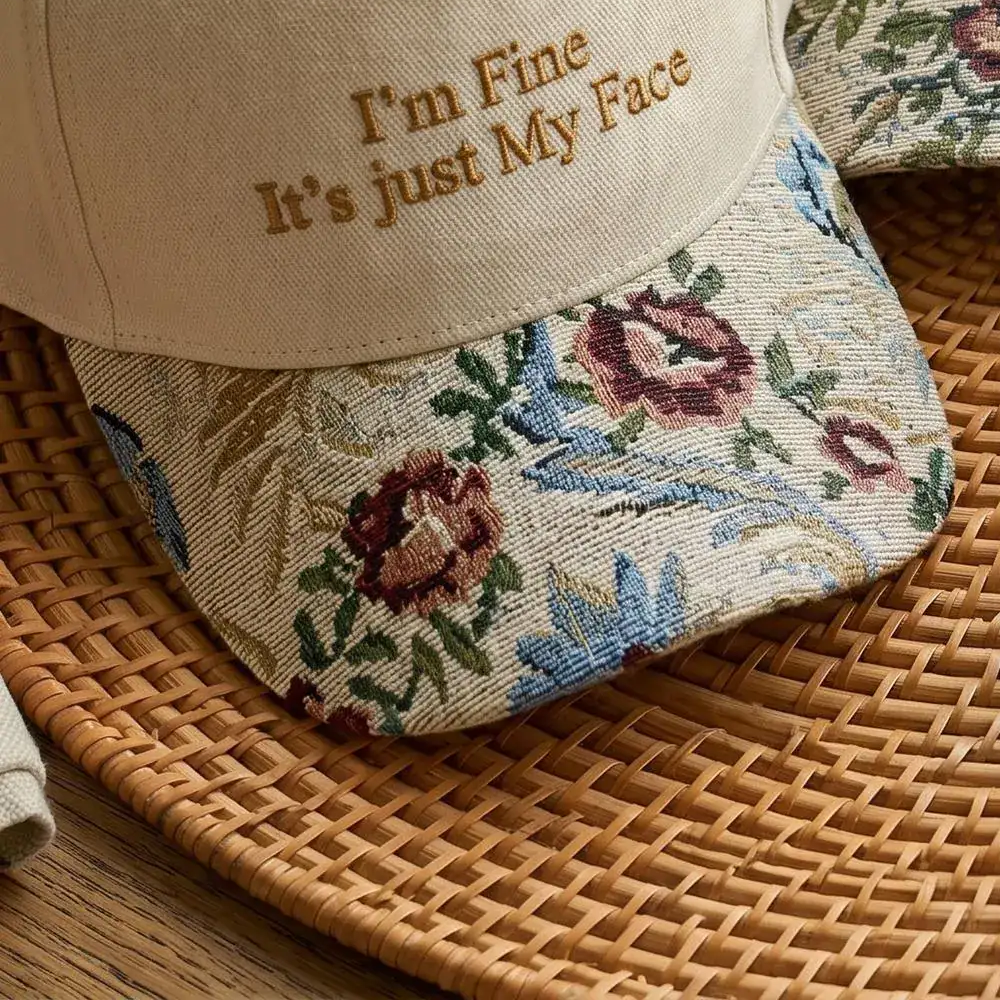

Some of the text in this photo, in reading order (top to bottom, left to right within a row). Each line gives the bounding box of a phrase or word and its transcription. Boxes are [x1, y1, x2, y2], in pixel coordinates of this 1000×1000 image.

[255, 47, 692, 235] It's just My Face
[351, 28, 590, 144] I'm Fine
